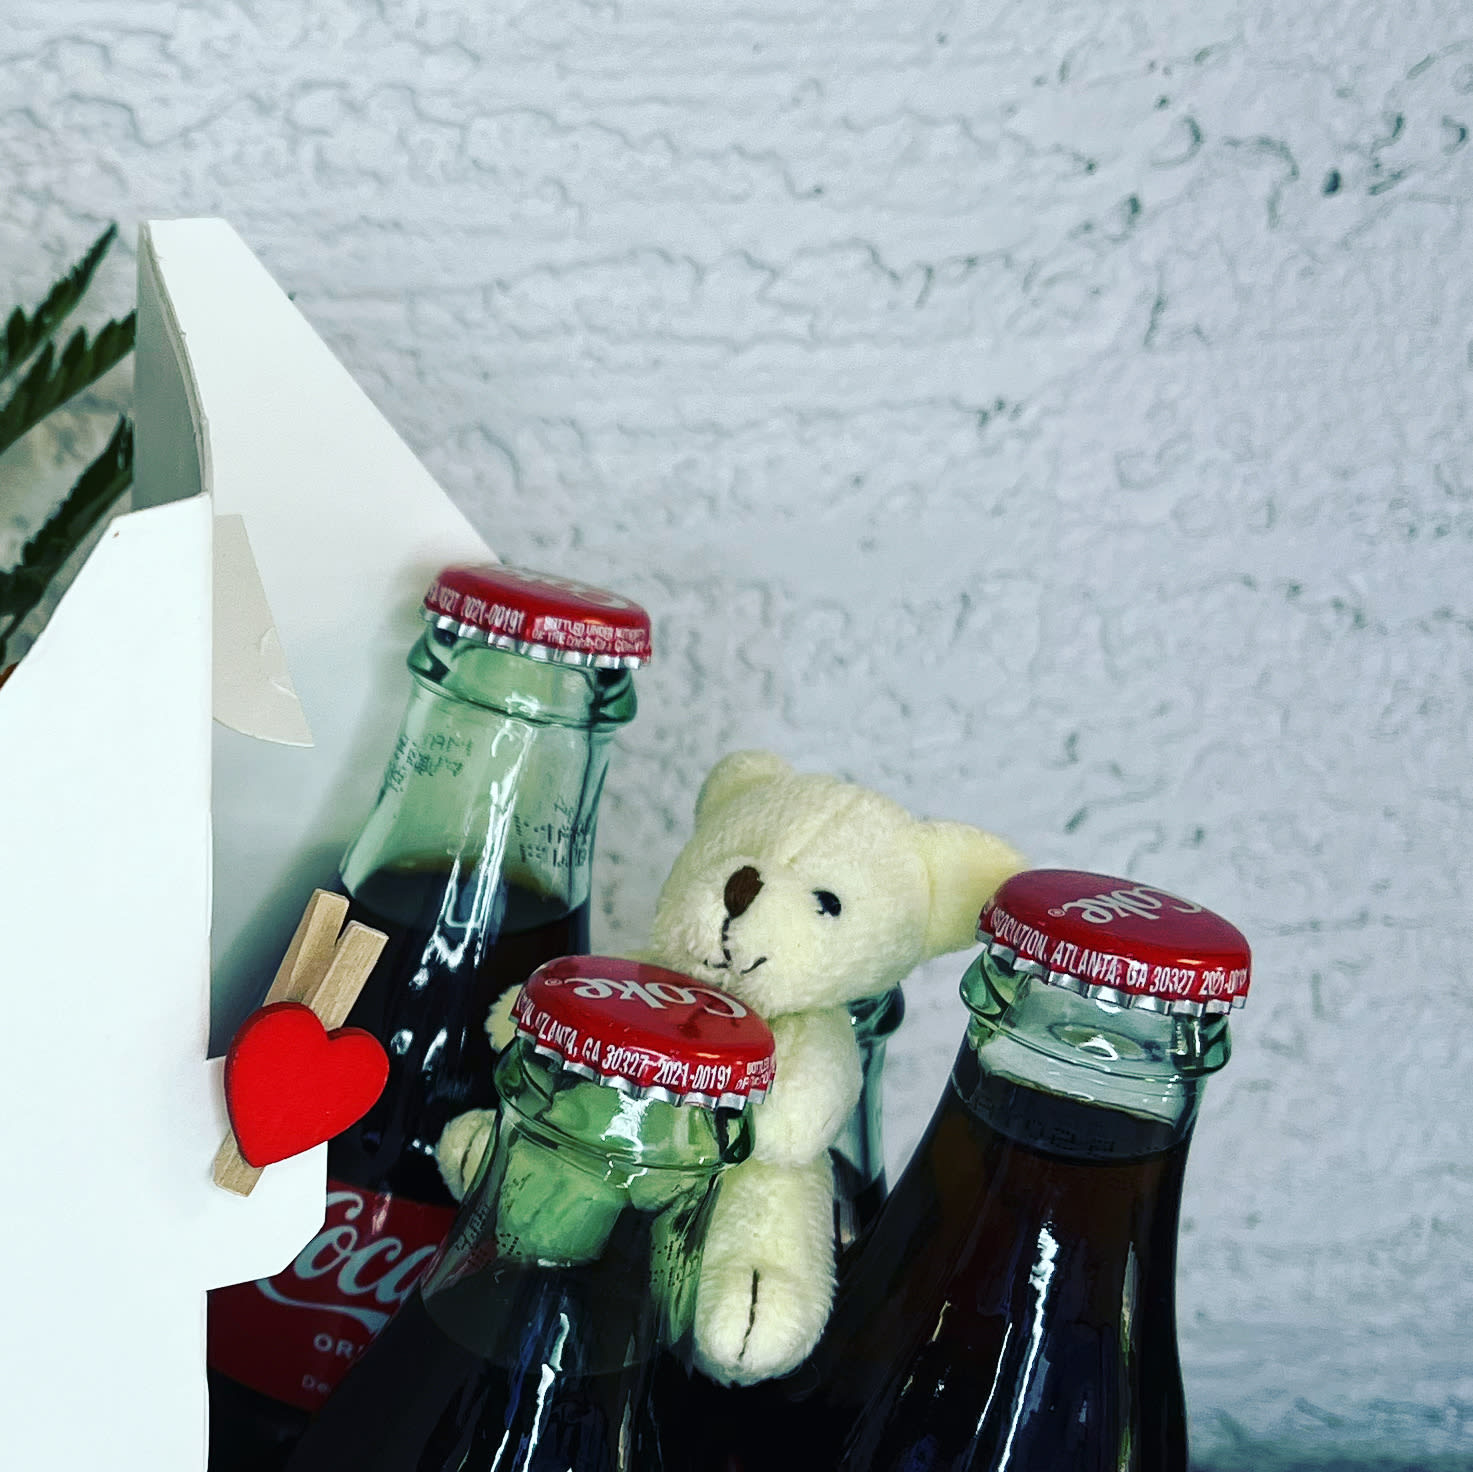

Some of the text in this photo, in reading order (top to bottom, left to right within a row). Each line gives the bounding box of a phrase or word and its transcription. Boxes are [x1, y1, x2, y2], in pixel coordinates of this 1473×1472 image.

[1049, 940, 1122, 985] ATLANTA,
[1126, 960, 1148, 988] GA
[1149, 966, 1196, 996] 30327
[563, 977, 748, 1019] Coke
[582, 1037, 602, 1063] GA
[602, 1044, 649, 1078] 30327
[652, 1058, 733, 1091] 2021-00191
